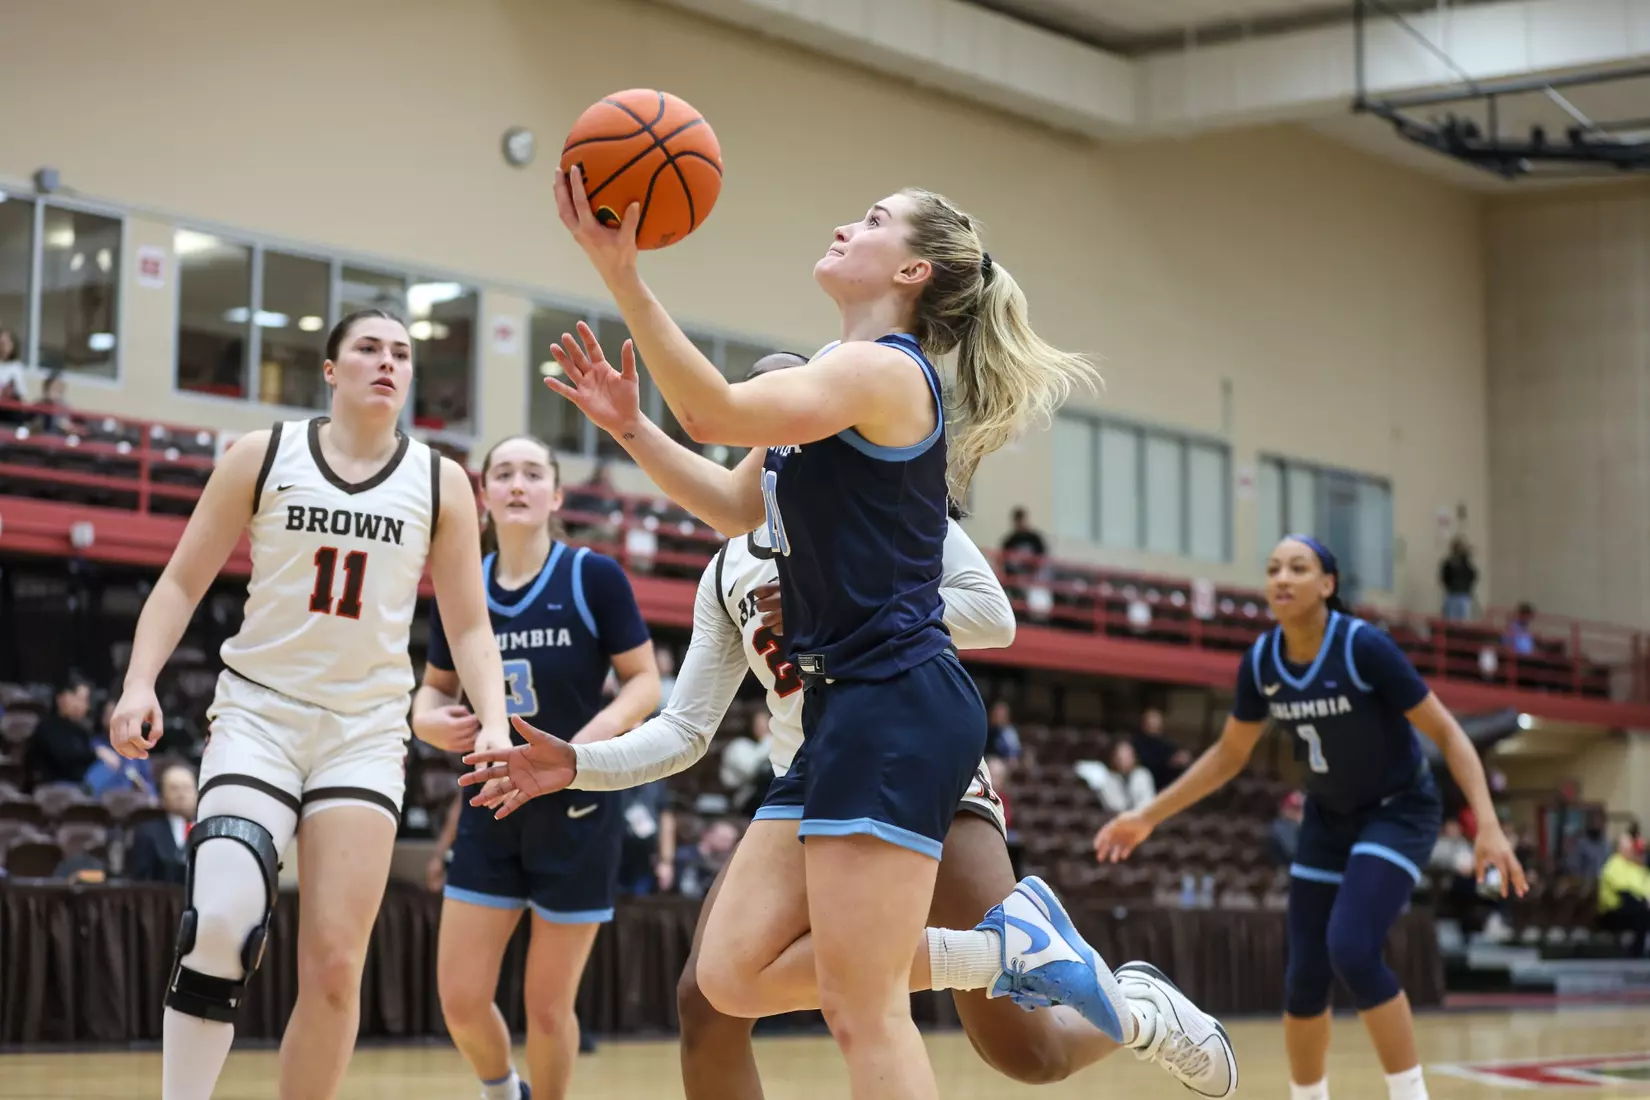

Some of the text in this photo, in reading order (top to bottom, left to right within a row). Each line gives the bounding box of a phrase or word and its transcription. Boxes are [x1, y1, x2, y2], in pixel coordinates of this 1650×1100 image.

[286, 505, 404, 545] BROWN
[309, 546, 368, 620] 11
[495, 627, 572, 652] UMBIA
